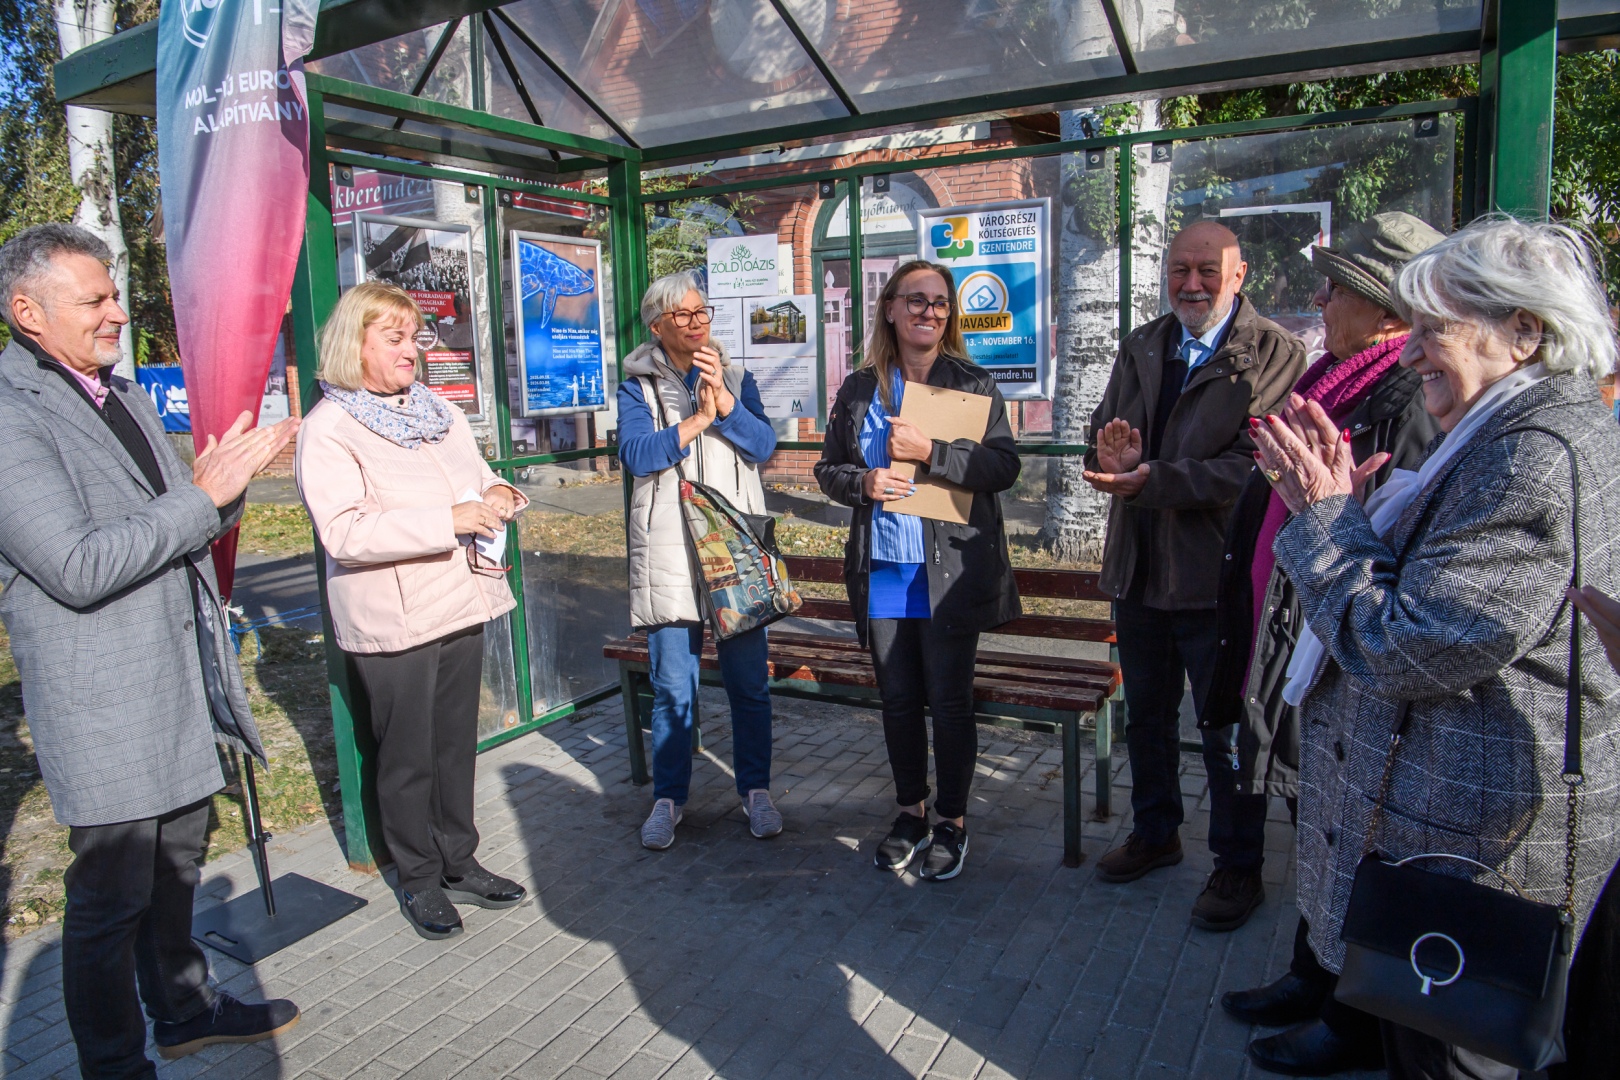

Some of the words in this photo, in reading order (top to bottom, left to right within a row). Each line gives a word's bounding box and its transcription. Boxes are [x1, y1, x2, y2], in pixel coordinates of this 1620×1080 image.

[239, 64, 291, 93] EURÓ
[194, 96, 303, 135] ALAPÍTVÁNY
[979, 211, 1036, 227] VÁROSRÉSZI
[979, 225, 1036, 239] KÖLTSÉGVETÉS
[981, 240, 1033, 254] SZENTENDRE
[960, 316, 1008, 329] JAVASLAT
[966, 338, 976, 347] 13.
[983, 336, 1022, 346] NOVEMBER
[1024, 336, 1036, 345] 16.
[989, 369, 1034, 380] ntendre.hu
